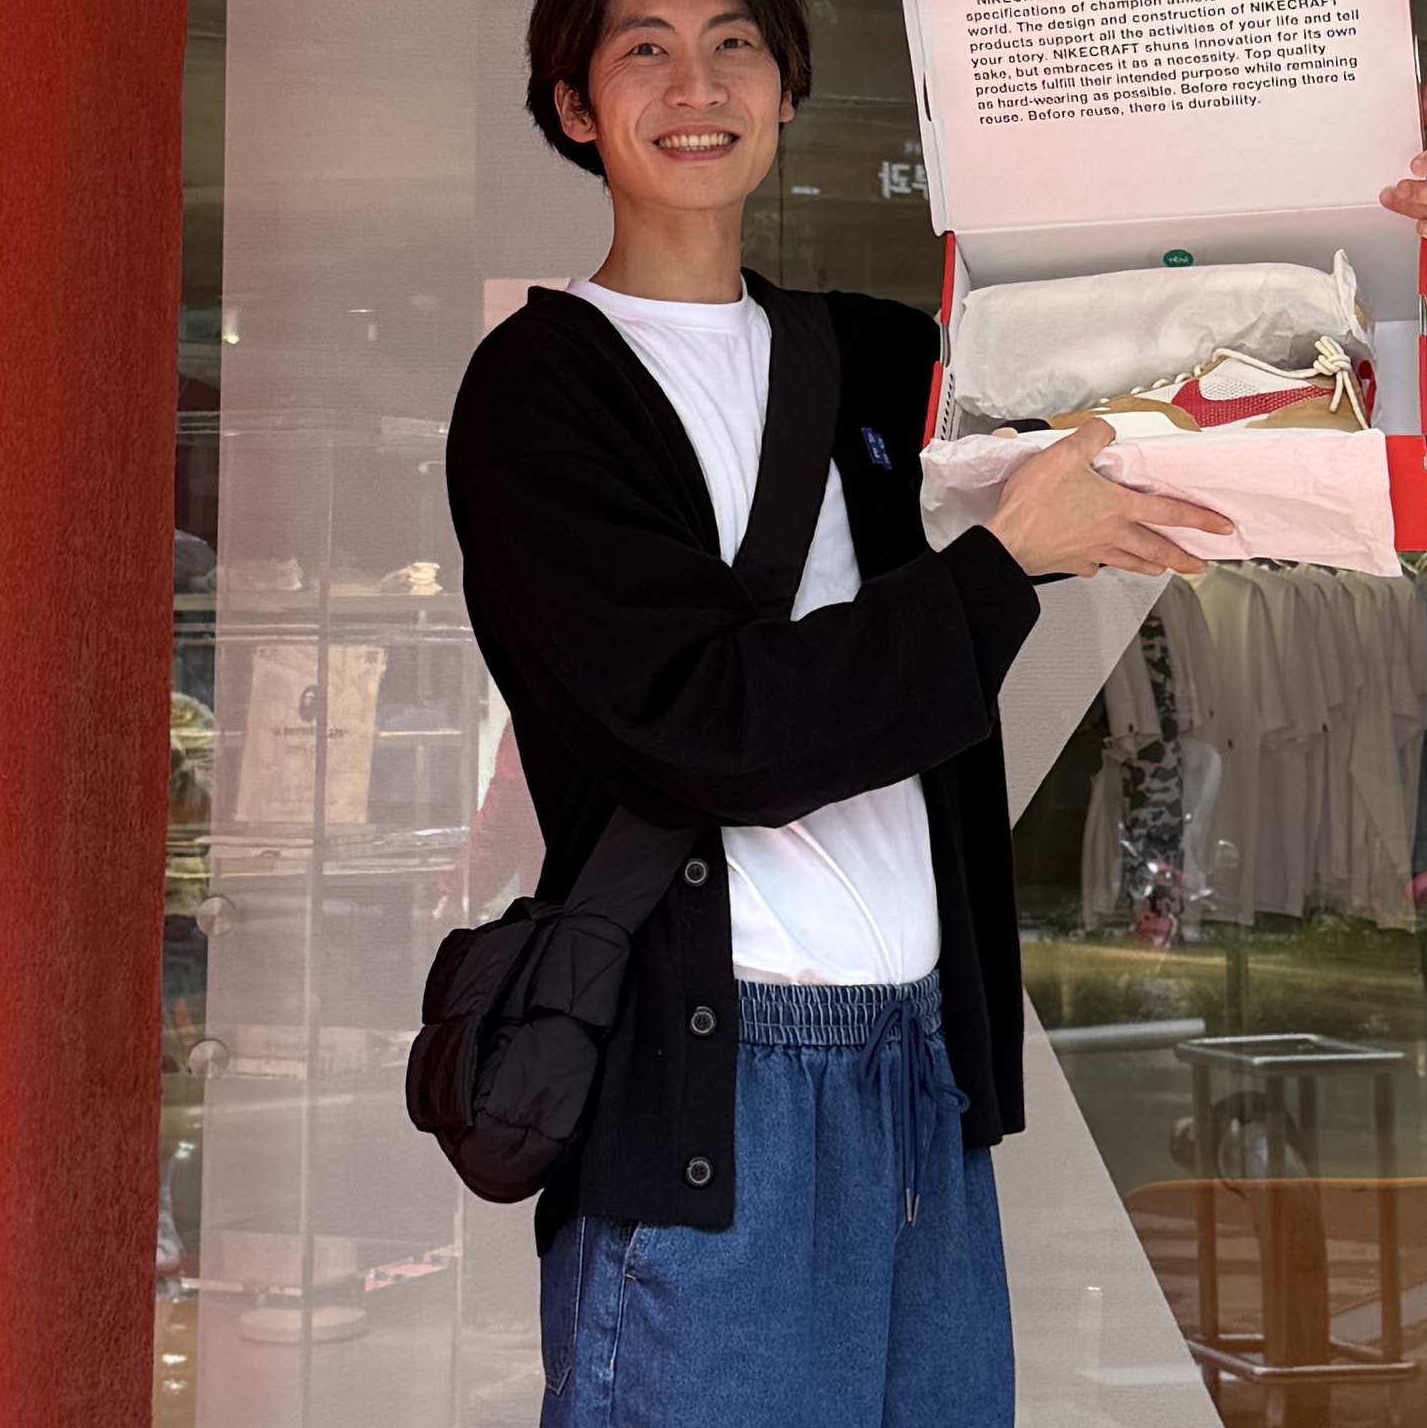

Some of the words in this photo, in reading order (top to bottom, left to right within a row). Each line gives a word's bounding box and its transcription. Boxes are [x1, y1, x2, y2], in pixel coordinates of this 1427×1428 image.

[966, 5, 1066, 23] specifications
[1071, 1, 1085, 13] of
[967, 23, 1012, 37] world.
[1016, 21, 1043, 32] The
[1047, 17, 1095, 30] design
[1101, 13, 1127, 26] and
[1132, 6, 1226, 23] construction
[1231, 3, 1245, 15] of
[969, 38, 1033, 54] products
[1038, 32, 1095, 47] support
[1099, 29, 1115, 41] all
[1120, 28, 1143, 39] the
[1149, 23, 1215, 37] activities
[1220, 20, 1234, 31] of
[1238, 19, 1271, 32] your
[1276, 15, 1299, 27] life
[1304, 11, 1331, 24] and
[1336, 9, 1359, 21] tell
[971, 56, 1003, 69] your
[1008, 53, 1048, 63] story.
[1053, 42, 1139, 60] NIKECRAFT
[1145, 41, 1189, 53] shuns
[1194, 33, 1272, 49] innovation
[1277, 31, 1298, 42] for
[1303, 29, 1321, 40] its
[1326, 27, 1356, 38] own
[974, 68, 1011, 81] sake,
[1015, 66, 1039, 77] but
[1043, 62, 1113, 75] embraces
[1118, 58, 1127, 69] it
[1132, 59, 1148, 68] as
[1154, 58, 1162, 67] a
[1167, 51, 1239, 66] necessity.
[1244, 48, 1272, 60] Top
[1277, 43, 1326, 59] quality
[976, 81, 1038, 97] products
[1041, 77, 1075, 90] fulfill
[1080, 75, 1112, 87] their
[1116, 69, 1177, 84] intended
[1181, 67, 1240, 81] purpose
[1244, 61, 1282, 74] while
[1287, 56, 1357, 71] remaining
[978, 101, 994, 110] as
[997, 92, 1088, 108] hard-wearing
[1093, 92, 1109, 101] as
[1113, 85, 1176, 102] possible.
[1180, 82, 1228, 94] Before
[1232, 76, 1297, 91] recycling
[1301, 73, 1338, 85] there
[1343, 71, 1355, 81] is
[979, 114, 1023, 125] reuse.
[1028, 109, 1075, 121] Before
[1080, 106, 1124, 117] reuse,
[1129, 102, 1166, 113] there
[1171, 100, 1184, 110] is
[1188, 94, 1261, 109] durability.
